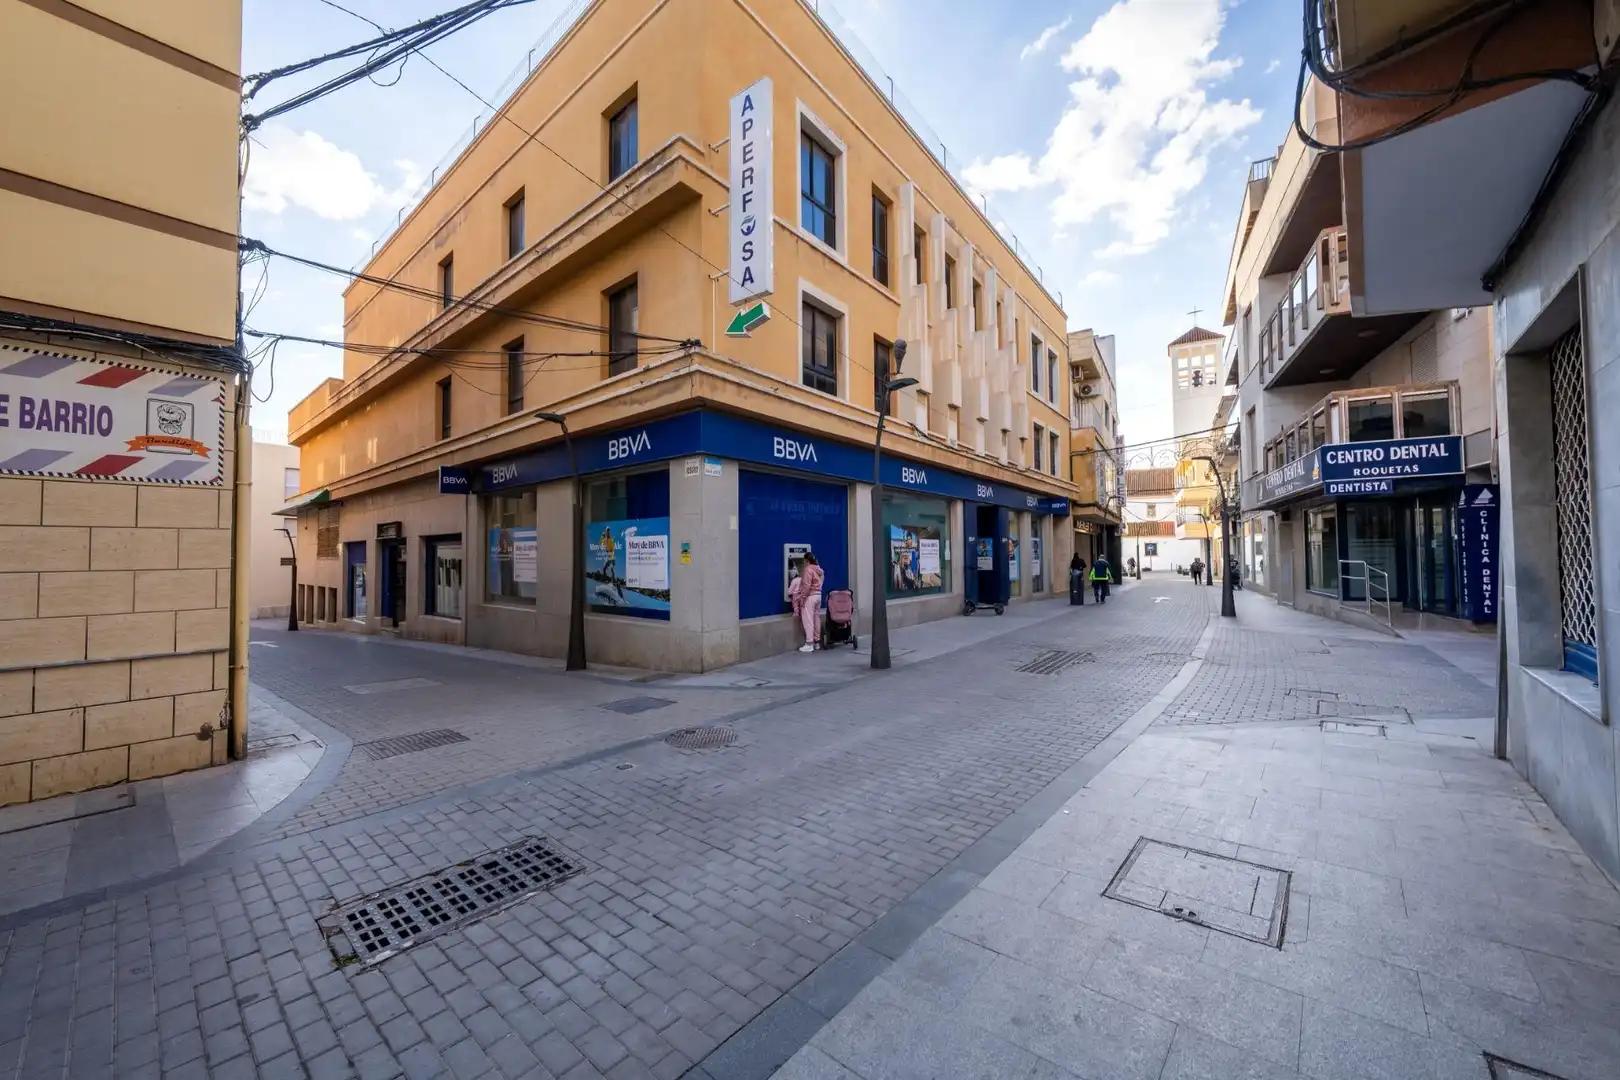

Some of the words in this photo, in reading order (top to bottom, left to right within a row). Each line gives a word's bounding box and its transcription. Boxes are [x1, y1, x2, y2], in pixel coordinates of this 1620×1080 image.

[19, 396, 113, 437] BARRIO
[608, 430, 651, 460] BBVA
[773, 436, 818, 463] BBVA
[1326, 447, 1384, 466] CENTRO
[1390, 442, 1450, 461] DENTAL
[443, 475, 467, 485] BBVA
[492, 463, 518, 484] BBVA
[901, 466, 927, 485] BBVA
[1353, 464, 1420, 477] ROQUETAS
[976, 484, 994, 498] BBVA
[1330, 481, 1388, 493] DENTISTA
[1026, 495, 1039, 507] BBVA
[628, 541, 640, 551] Muy
[640, 540, 648, 550] de
[648, 540, 665, 550] BBVA
[1479, 510, 1491, 563] CLÍNICA
[1482, 569, 1492, 613] DENTAL
